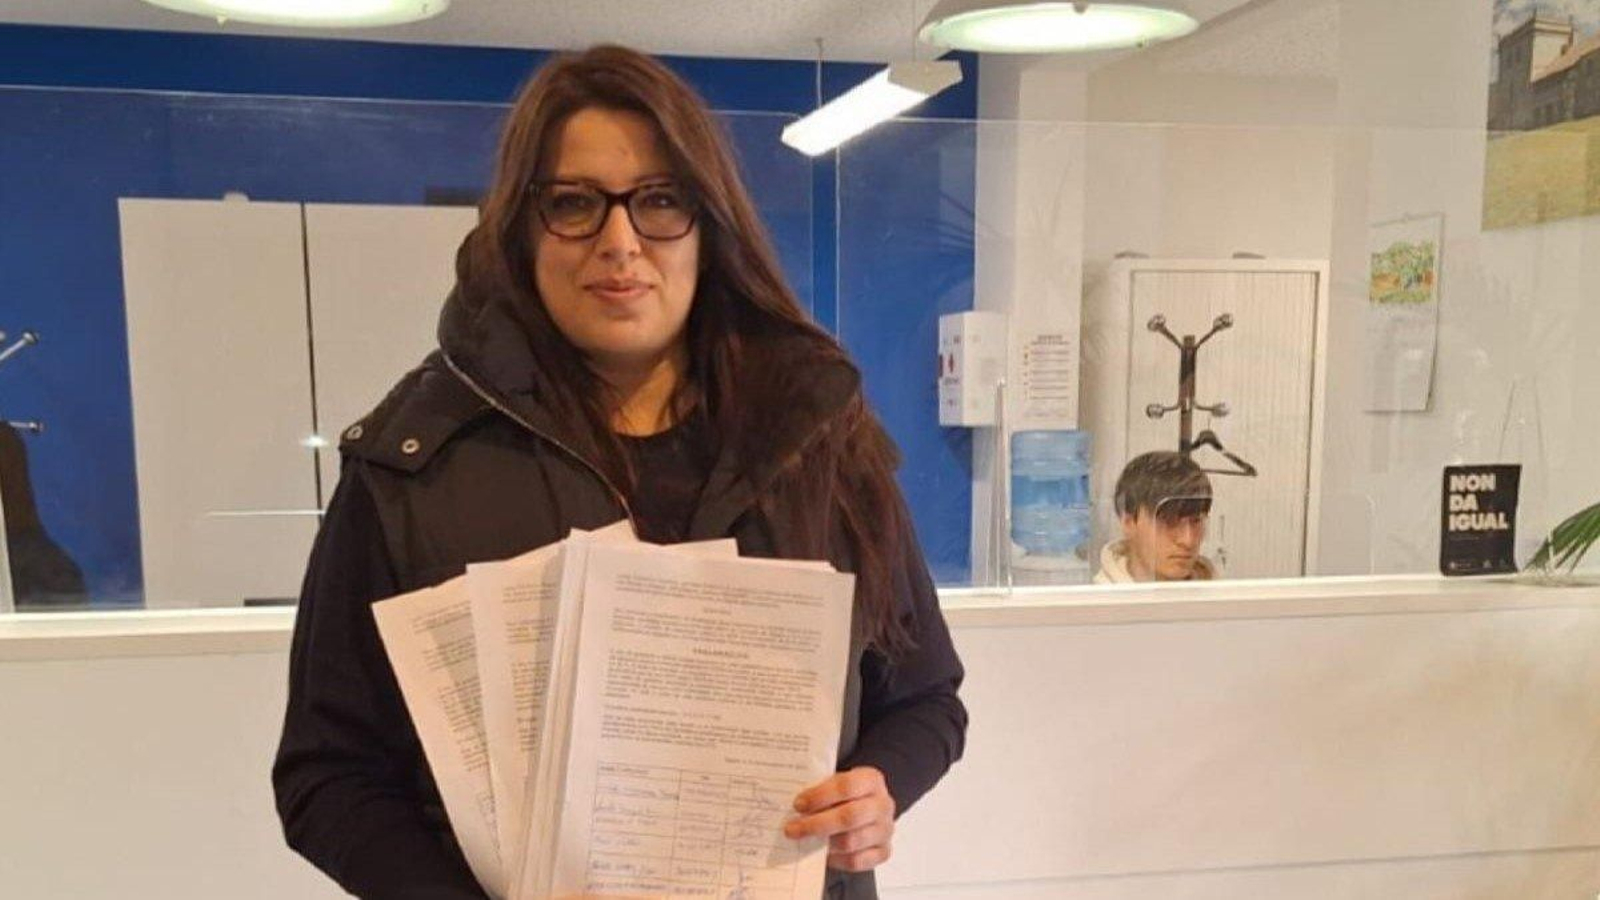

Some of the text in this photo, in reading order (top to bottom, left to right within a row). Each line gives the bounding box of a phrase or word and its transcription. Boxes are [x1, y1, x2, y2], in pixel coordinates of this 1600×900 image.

[1450, 473, 1496, 492] NON
[1450, 494, 1478, 512] DA
[1449, 512, 1508, 531] IGUAL
